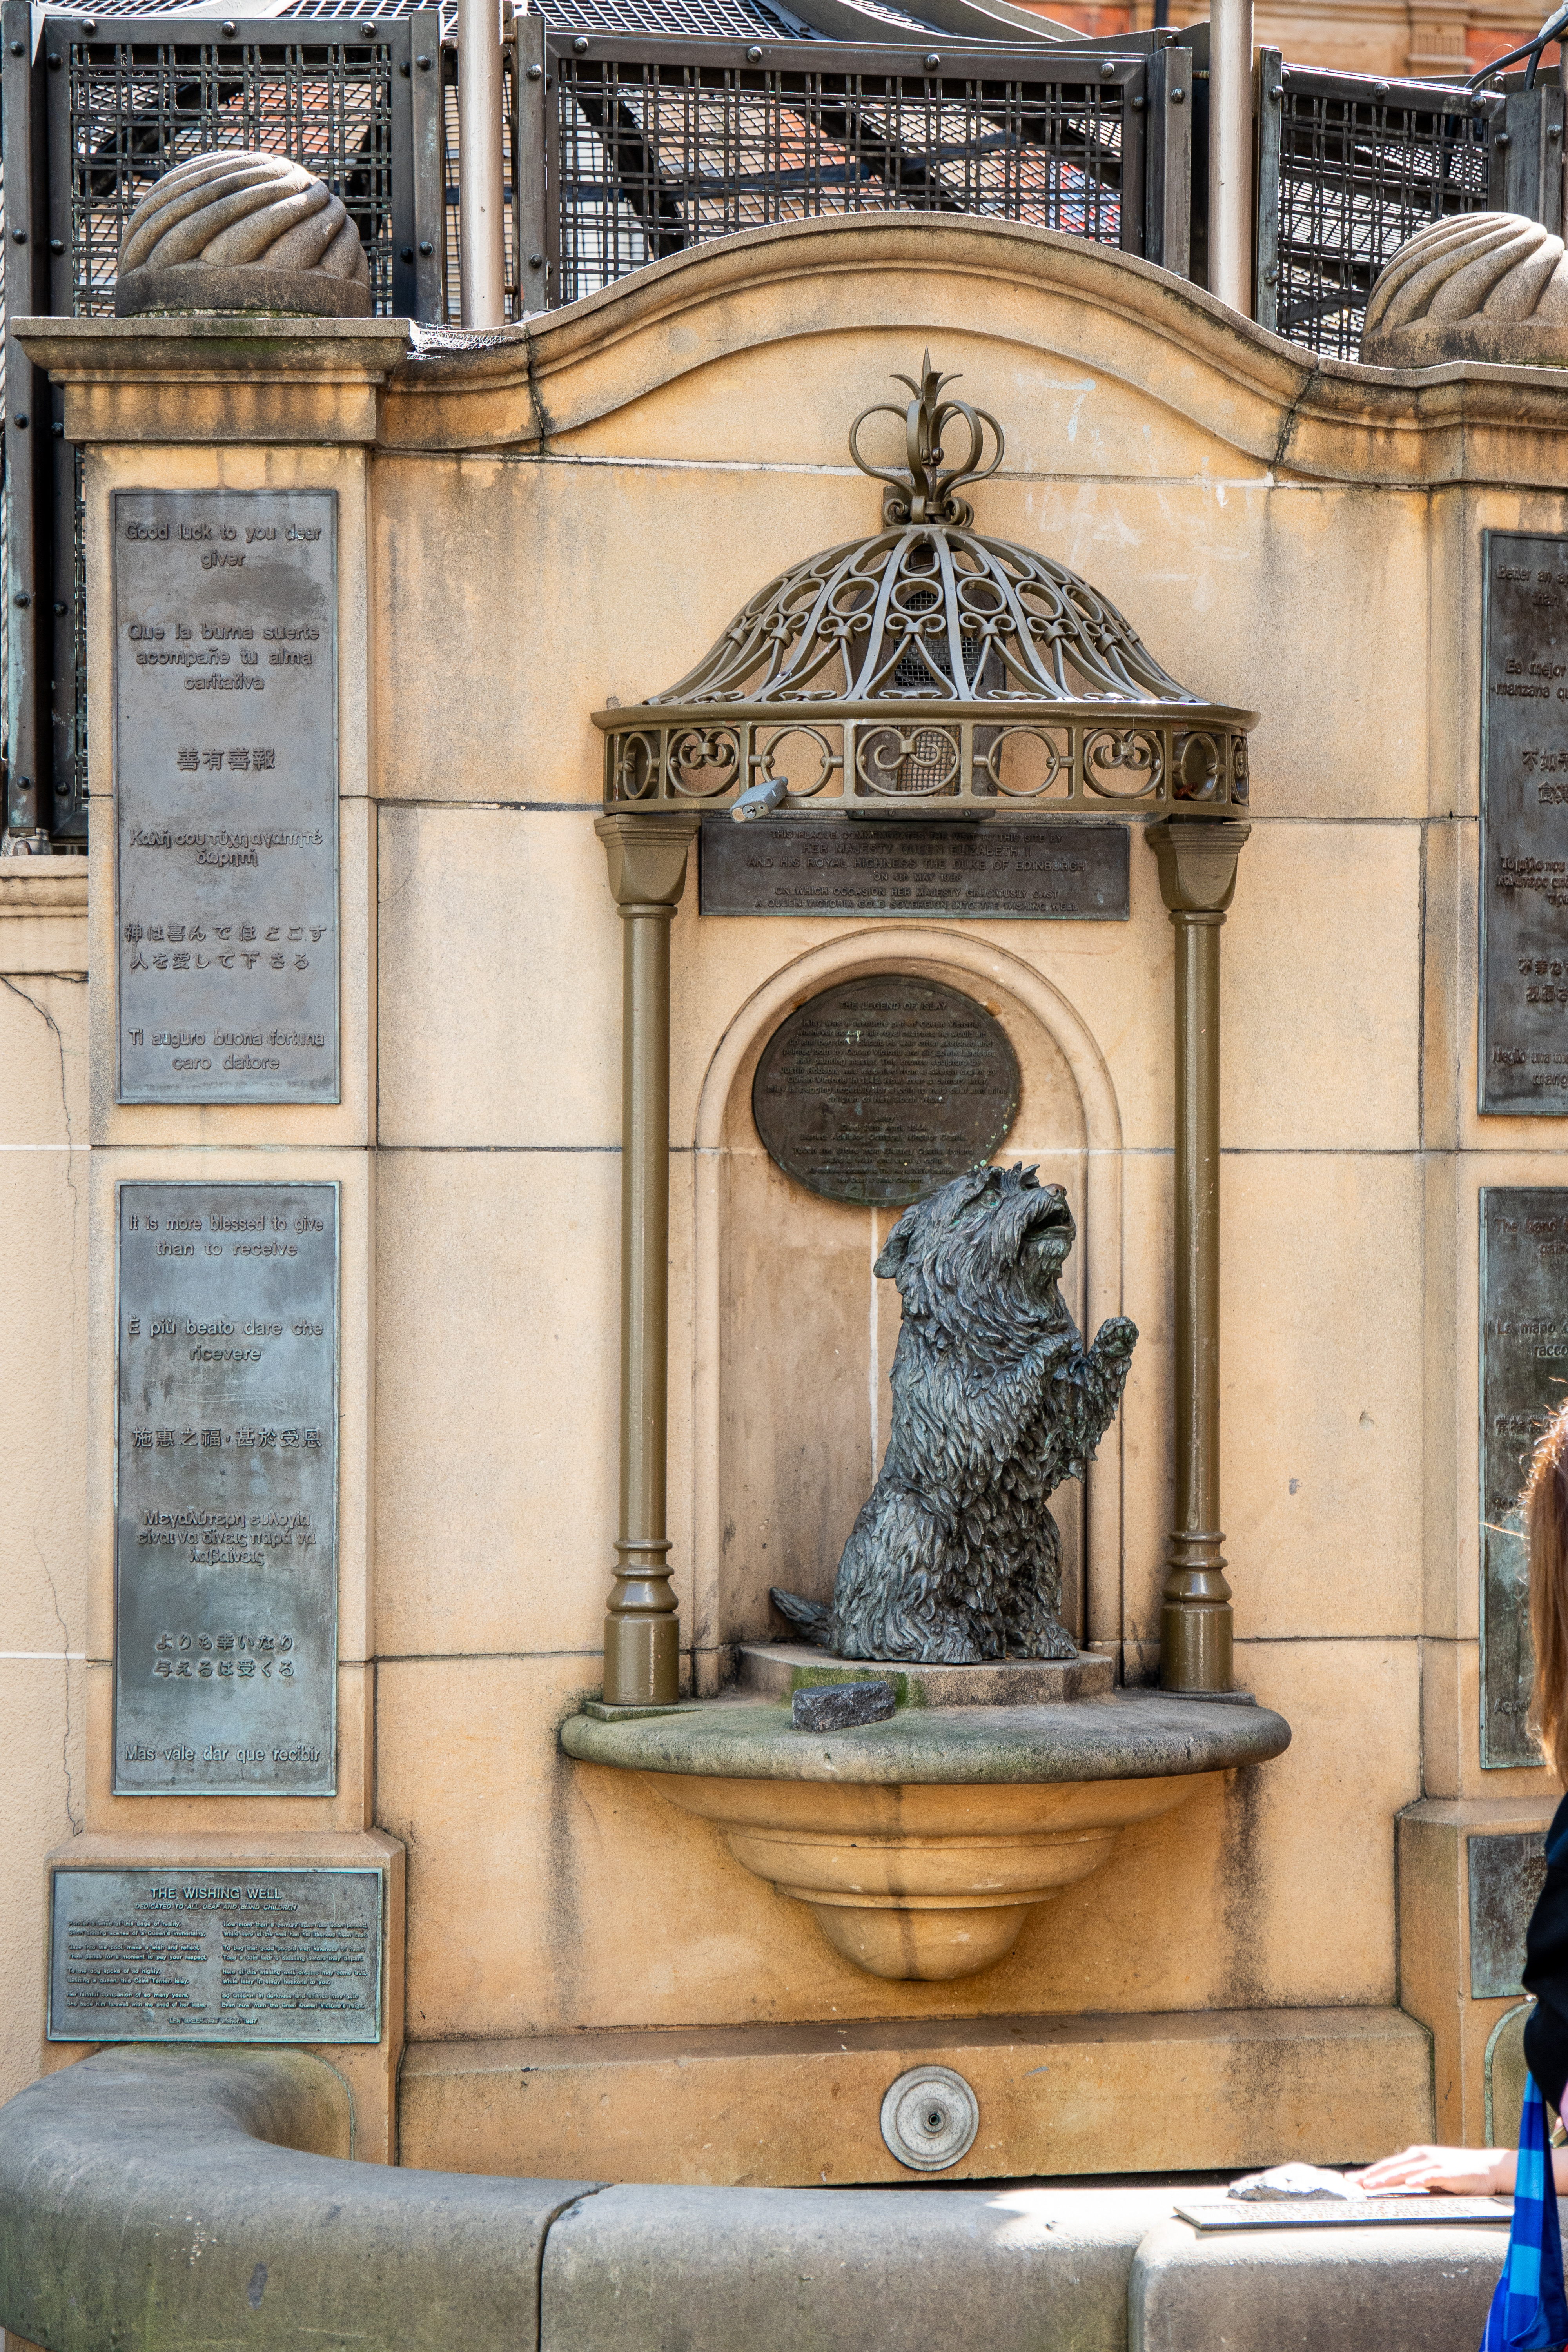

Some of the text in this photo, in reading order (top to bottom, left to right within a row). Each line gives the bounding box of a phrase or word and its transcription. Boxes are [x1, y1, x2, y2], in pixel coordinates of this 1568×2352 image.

[125, 523, 321, 543] Good luck to you dear
[201, 550, 246, 569] giver
[1537, 570, 1552, 582] an
[128, 625, 165, 640] Que
[175, 624, 191, 639] la
[263, 624, 320, 640] suerte
[136, 648, 312, 667] acompañe tu alma
[1505, 658, 1566, 679] Es mejor
[184, 673, 265, 690] caritativa
[1496, 682, 1550, 699] manzana
[176, 748, 275, 771] 善有善報
[803, 844, 828, 853] HER
[835, 844, 893, 854] MAJESTY
[902, 845, 943, 855] QUEEN
[951, 845, 1018, 856] ELIZABETH
[748, 857, 1086, 871] AND HIS ROYAL HIGHNESS THE DUKE OF EDINBURGH
[914, 873, 935, 882] MAY
[775, 887, 1058, 898] ON WHICH OCCASION HER MAJESTY GRACIOUSLY CAST
[767, 900, 802, 908] QUEEN
[807, 900, 853, 908] VICTORIA
[890, 901, 948, 909] SOVEREIGN
[952, 902, 975, 910] INTO
[980, 902, 999, 911] THE
[1004, 902, 1046, 911] WISHING
[1051, 903, 1078, 911] WELL
[128, 1029, 325, 1049] Ti auguro buona fortuna
[172, 1054, 280, 1071] caro datore
[129, 1216, 324, 1234] It is more blessed to give
[156, 1240, 298, 1256] than to receive
[150, 1319, 176, 1337] più
[186, 1320, 234, 1335] beato
[243, 1320, 282, 1335] dare
[292, 1319, 324, 1335] che
[189, 1345, 261, 1361] ricevere
[125, 1745, 320, 1764] Mas vale dar que recibir
[151, 1888, 282, 1899] THE WISHING WELL
